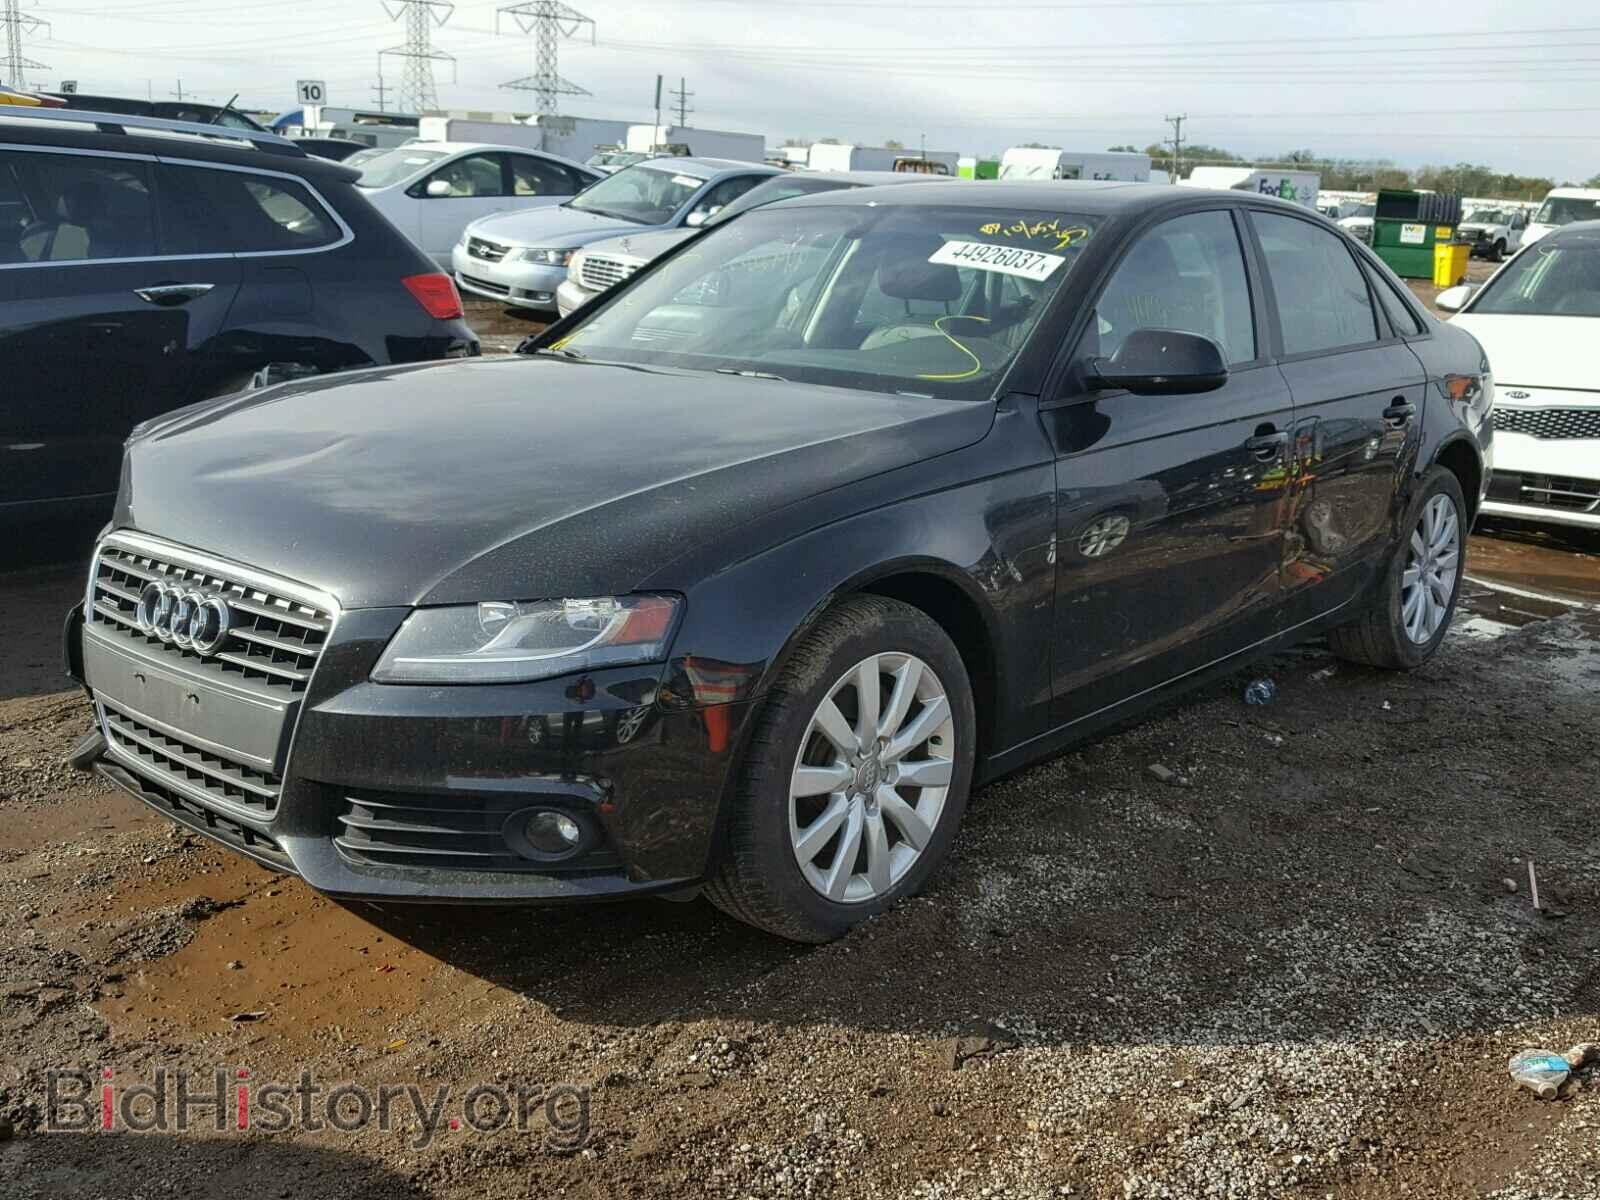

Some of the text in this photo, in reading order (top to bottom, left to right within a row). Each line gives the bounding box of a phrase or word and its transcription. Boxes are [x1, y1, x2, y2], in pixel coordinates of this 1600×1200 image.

[301, 84, 321, 100] 10
[1258, 178, 1298, 201] FedEx
[952, 243, 1045, 271] 44926037
